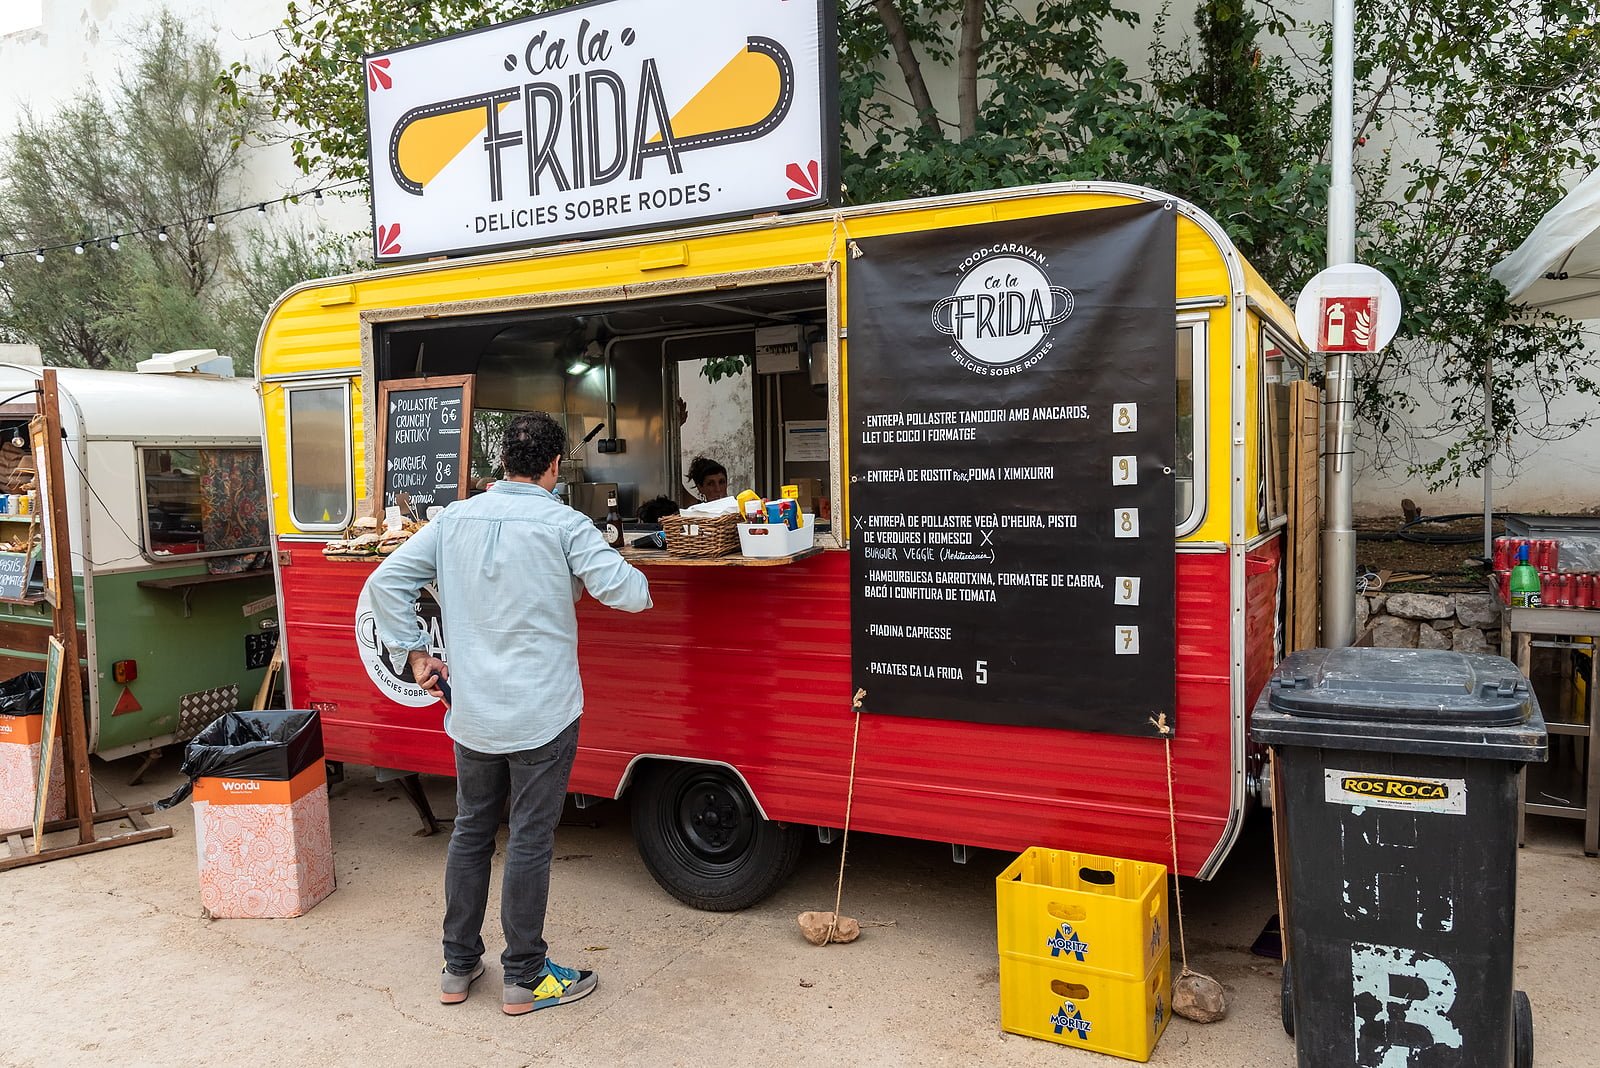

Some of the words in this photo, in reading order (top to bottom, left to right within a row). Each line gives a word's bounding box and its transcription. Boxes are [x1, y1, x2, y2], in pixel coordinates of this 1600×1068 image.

[525, 30, 569, 75] Ca
[577, 18, 613, 66] la
[475, 205, 558, 233] DELÍCIES
[565, 194, 632, 221] SOBRE
[639, 182, 711, 211] RODES
[958, 243, 1046, 272] FOOD-CARAVAN
[984, 275, 1002, 289] Ca
[1005, 273, 1019, 288] la
[950, 349, 988, 375] DELÍCIES
[990, 365, 1023, 376] SOBRE
[1024, 341, 1053, 369] RODES
[397, 397, 438, 412] POLLASTRE
[396, 413, 431, 428] CRUNCHY
[441, 407, 457, 424] 6€
[867, 412, 904, 427] ENTREPÀ
[907, 411, 957, 426] POLLASTRE
[959, 409, 1006, 424] TANDOORI
[1009, 407, 1030, 421] AMB
[1032, 405, 1091, 420] ANACARDS,
[1118, 407, 1131, 426] 8
[395, 427, 431, 444] KENTUKY
[862, 431, 881, 444] LLET
[883, 430, 894, 443] DE
[896, 429, 921, 442] COCO
[922, 429, 926, 442] I
[928, 427, 976, 442] FORMATGE
[393, 455, 428, 471] BURGUER
[435, 461, 452, 482] 8€
[1118, 458, 1129, 481] 9
[392, 473, 428, 489] CRUNCHY
[867, 467, 905, 482] ENTREPÀ
[907, 469, 919, 482] DE
[920, 469, 952, 482] ROSTIT
[969, 467, 996, 481] POMA
[998, 467, 1002, 480] I
[1003, 467, 1054, 480] XIMIXURRI
[868, 512, 906, 528] ENTREPÀ
[907, 515, 919, 528] DE
[921, 515, 972, 528] POLLASTRE
[974, 512, 999, 528] VEGÀ
[1001, 515, 1045, 529] D'HEURA,
[1048, 515, 1077, 528] PISTO
[1121, 511, 1132, 532] 8
[864, 531, 875, 543] DE
[877, 531, 921, 544] VERDURES
[923, 531, 926, 544] I
[928, 532, 972, 544] ROMESCO
[903, 546, 935, 562] VEGGIE
[869, 569, 933, 584] HAMBURGUESA
[935, 571, 996, 586] GARROTXINA,
[998, 573, 1049, 587] FORMATGE
[1051, 574, 1064, 587] DE
[1067, 574, 1104, 589] CABRA,
[864, 584, 888, 598] BACÓ
[889, 586, 893, 598] I
[895, 586, 943, 600] CONFITURA
[945, 588, 957, 600] DE
[959, 588, 997, 602] TOMATA
[1122, 579, 1133, 600] 9
[870, 624, 904, 638] PIADINA
[906, 625, 952, 640] CAPRESSE
[1120, 629, 1133, 650] 7
[373, 663, 402, 694] DELÍCIES
[870, 662, 908, 676] PATATES
[909, 664, 921, 677] CA
[924, 665, 935, 678] LA
[937, 666, 964, 680] FRIDA
[976, 660, 988, 684] 5
[222, 780, 260, 791] Wondu
[1344, 779, 1385, 793] ROS
[1386, 781, 1446, 798] ROCA
[1046, 935, 1089, 954] MORITZ
[1050, 1013, 1092, 1033] MORITZ
